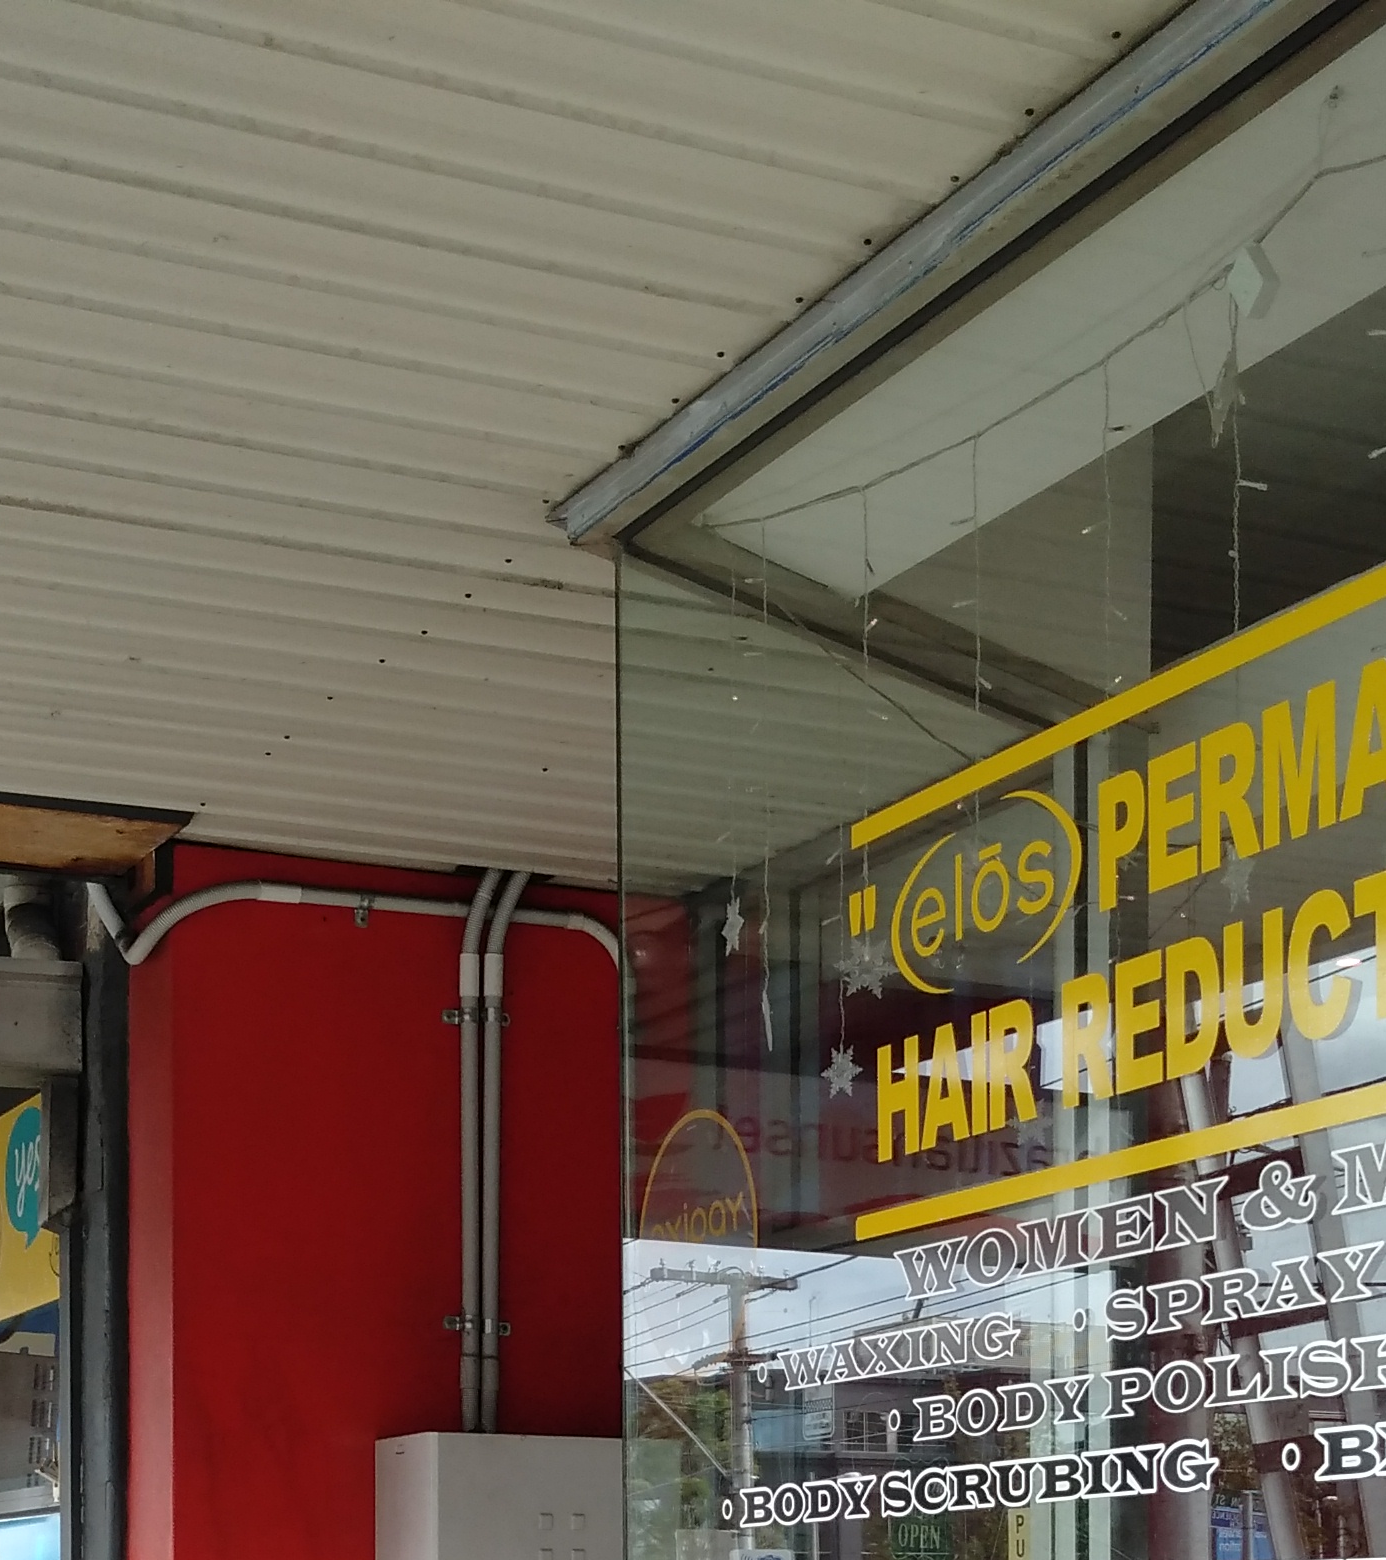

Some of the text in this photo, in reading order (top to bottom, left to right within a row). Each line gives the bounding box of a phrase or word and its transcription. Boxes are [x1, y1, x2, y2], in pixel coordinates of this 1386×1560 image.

[876, 996, 1038, 1162] HAIR
[893, 1174, 1230, 1300] WOMEN
[1241, 1160, 1318, 1232] &
[778, 1311, 1022, 1391] WAXING
[1105, 1240, 1386, 1342] SPRAY
[913, 1371, 1096, 1442] BODY
[740, 1472, 876, 1528] BODY
[881, 1436, 1219, 1518] SCRUBING
[898, 1523, 940, 1550] OPEN
